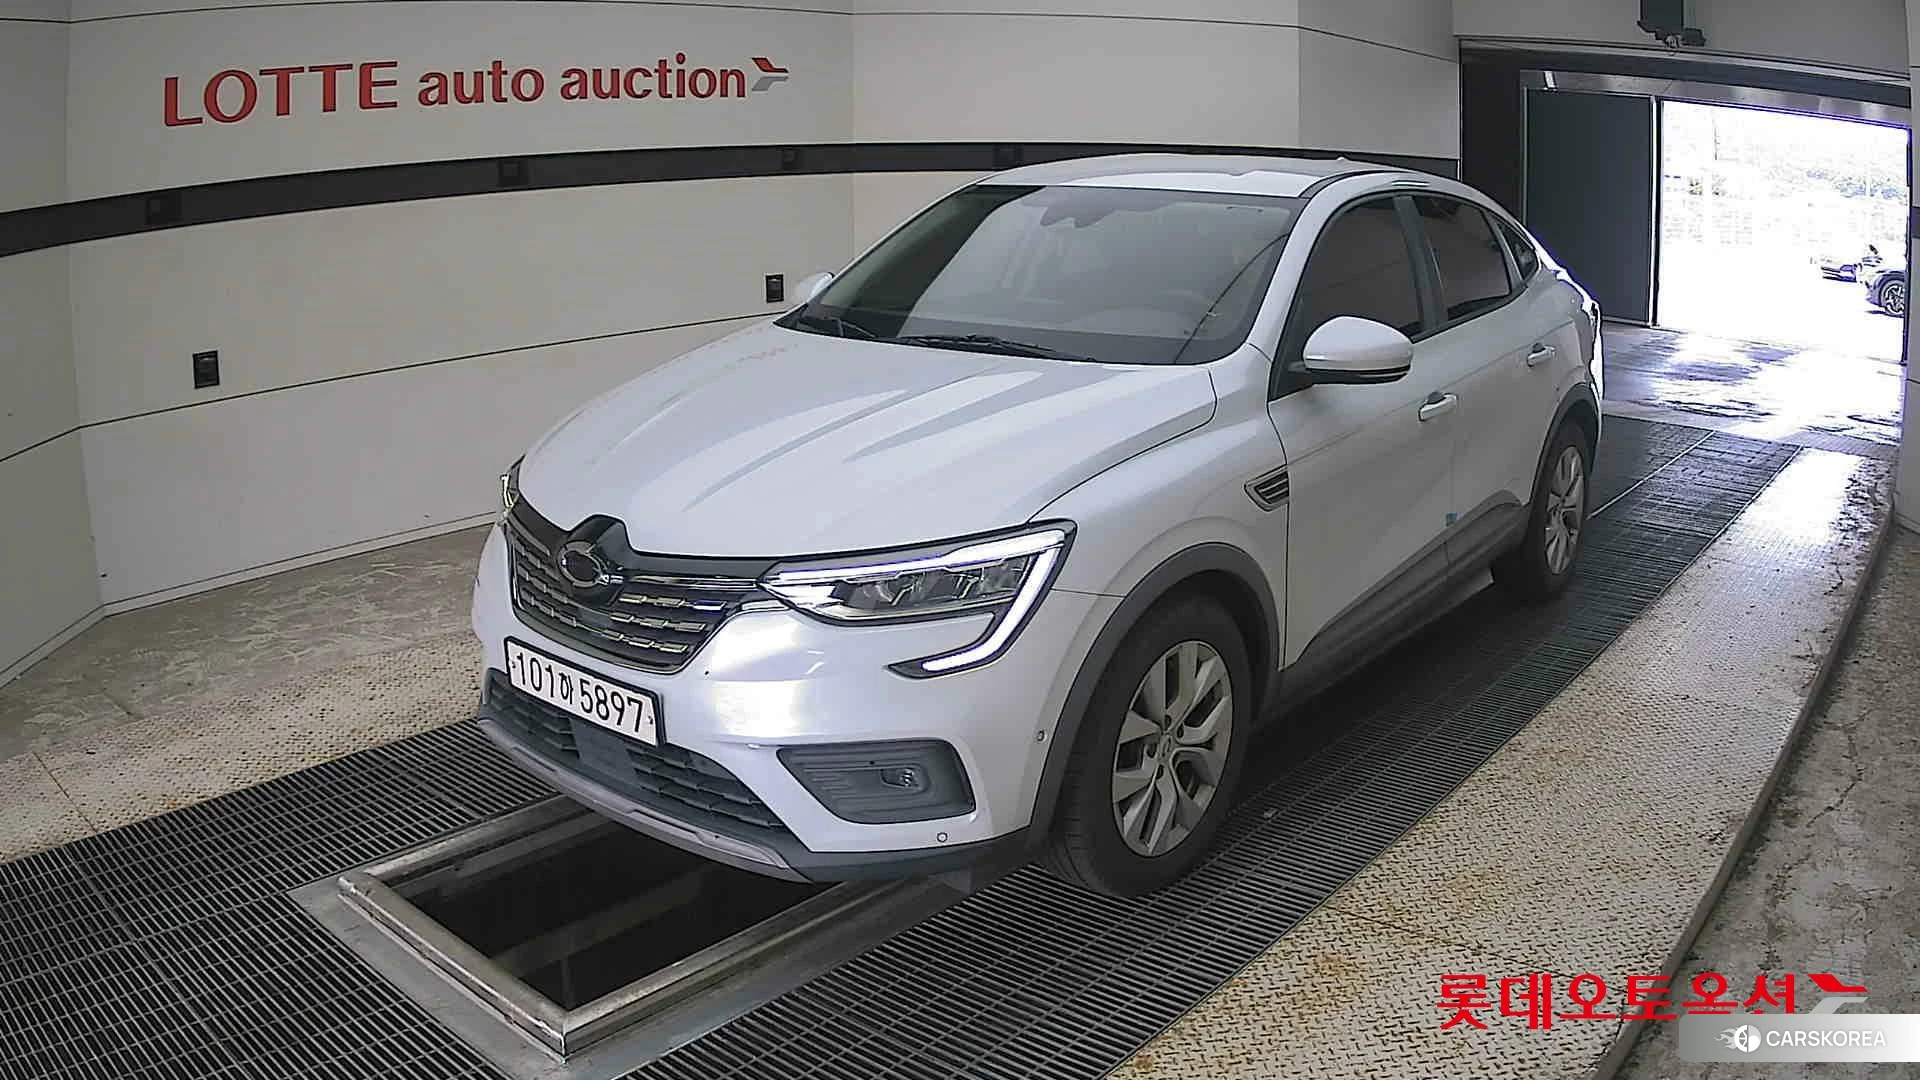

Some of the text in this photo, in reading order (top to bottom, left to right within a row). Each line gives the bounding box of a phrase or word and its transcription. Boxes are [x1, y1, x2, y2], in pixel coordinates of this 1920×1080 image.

[163, 52, 746, 127] LOTTE auto auction
